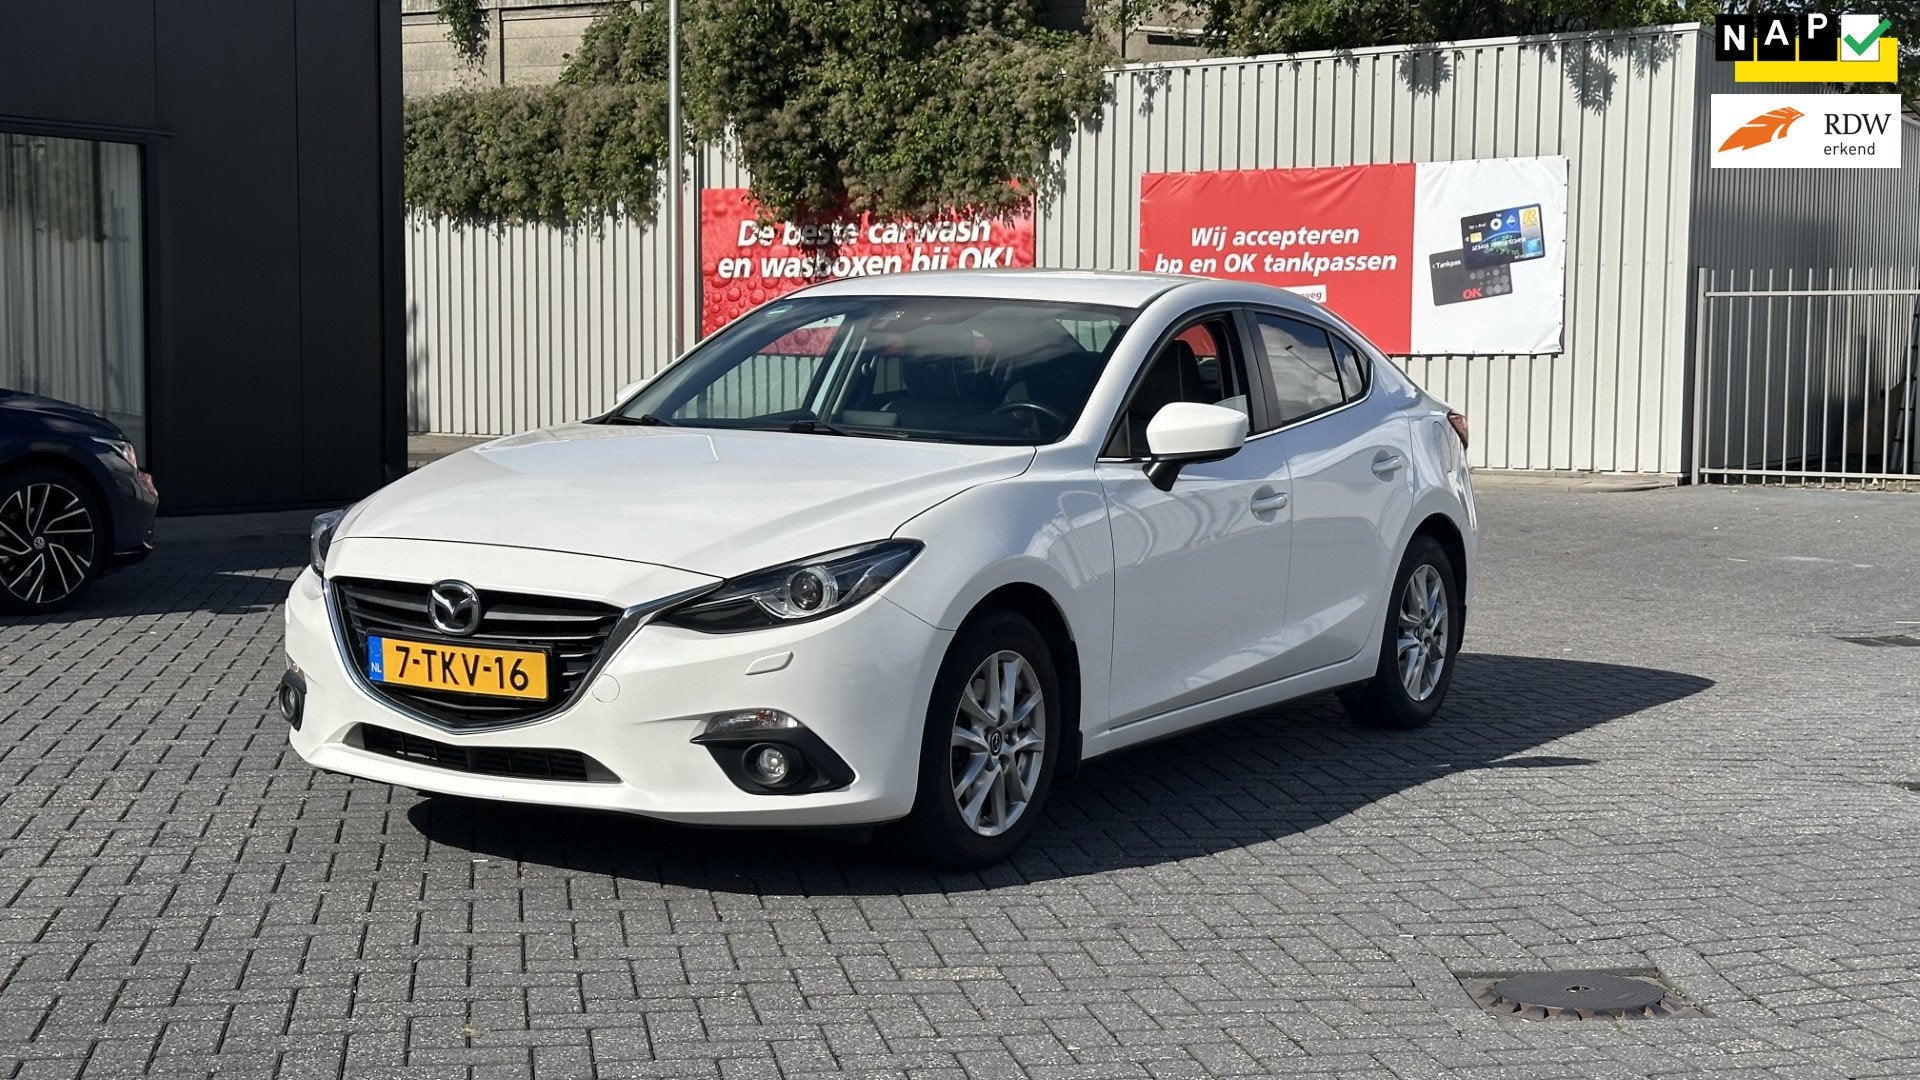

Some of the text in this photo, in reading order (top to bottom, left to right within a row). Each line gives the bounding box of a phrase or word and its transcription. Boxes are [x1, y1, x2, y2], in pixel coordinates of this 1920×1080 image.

[737, 214, 993, 247] De beste carwash
[1191, 226, 1360, 251] Wij accepteren
[717, 246, 1015, 279] en wasboxen bij OK!
[1154, 251, 1398, 277] bp en OK tankpassen
[1436, 259, 1462, 269] Tankpas
[1462, 287, 1483, 300] OK
[371, 645, 529, 691] NL 7-TKV-16
